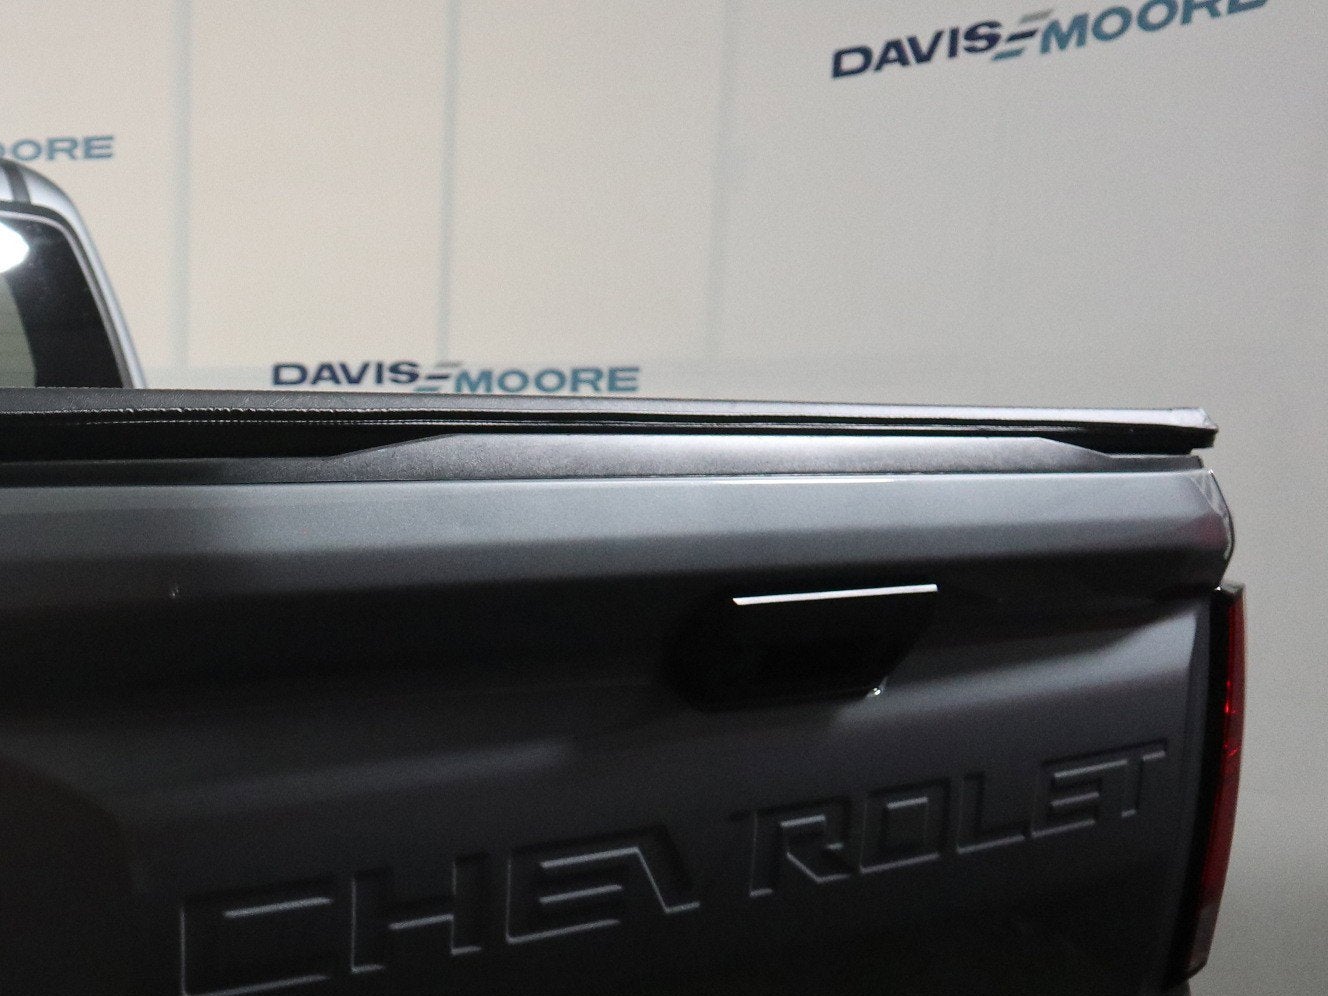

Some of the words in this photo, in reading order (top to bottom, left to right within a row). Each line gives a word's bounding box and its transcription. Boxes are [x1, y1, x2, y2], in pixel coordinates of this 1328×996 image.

[831, 21, 1003, 79] DAVIS
[272, 361, 420, 386] DAVIS
[454, 366, 640, 394] MOORE
